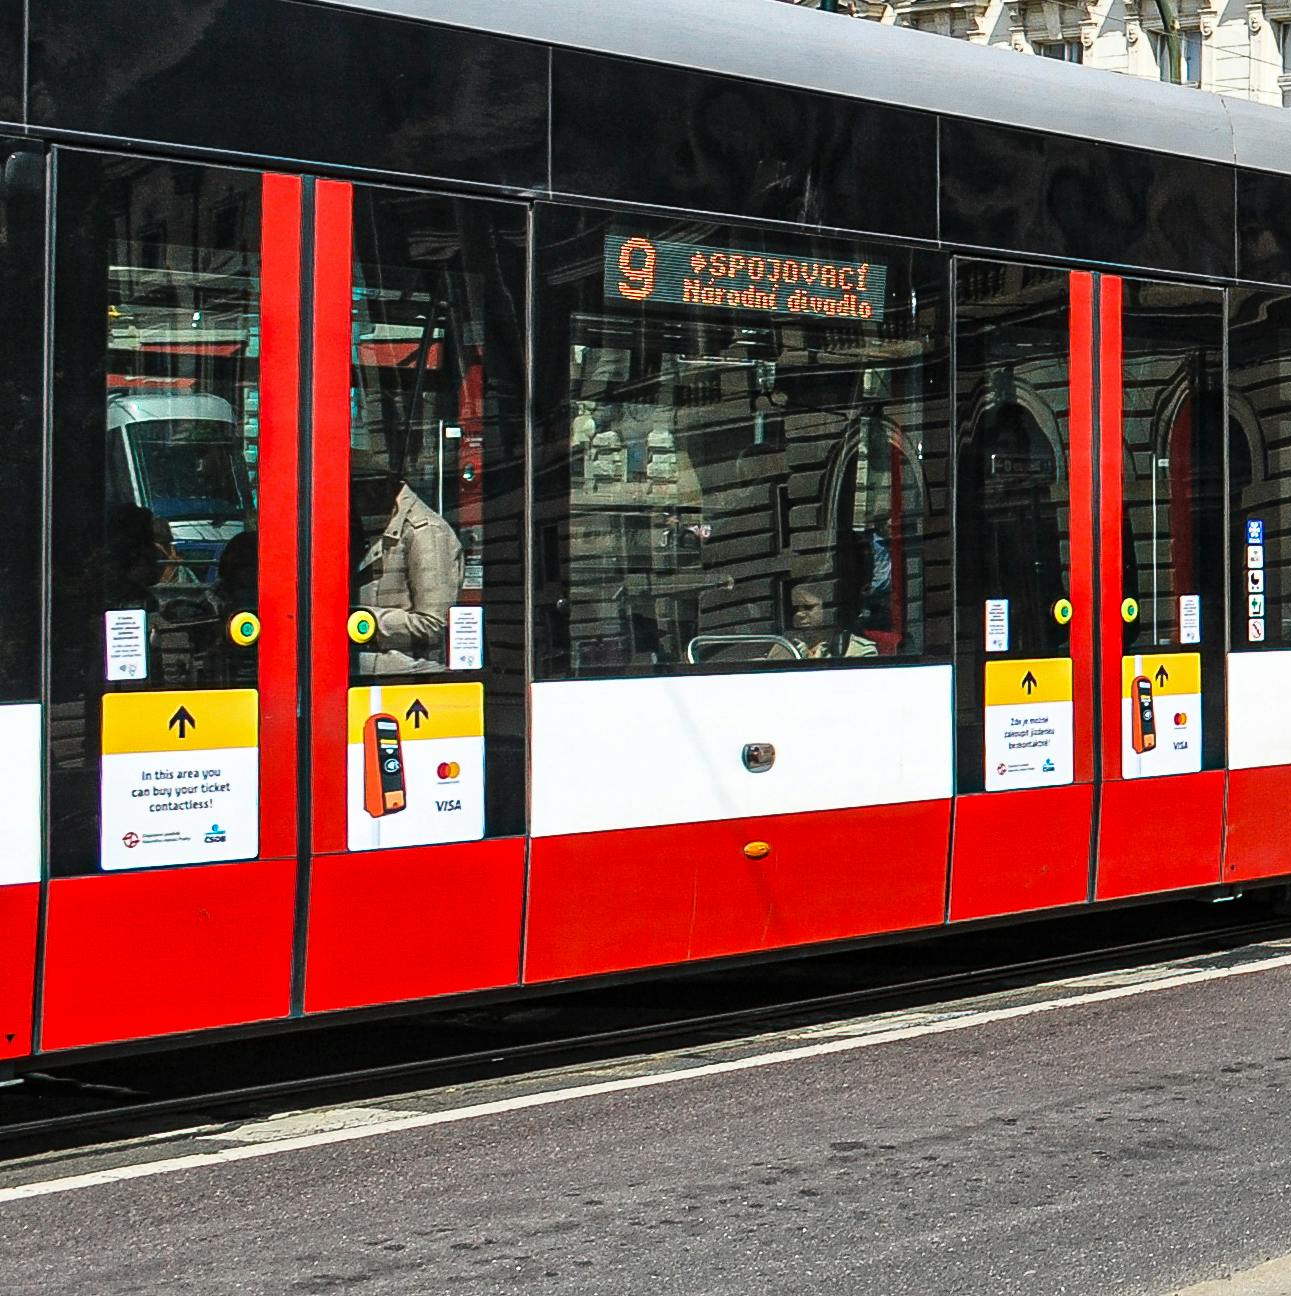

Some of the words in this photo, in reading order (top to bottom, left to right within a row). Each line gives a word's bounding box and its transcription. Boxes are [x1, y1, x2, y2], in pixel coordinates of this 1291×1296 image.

[618, 236, 657, 301] 9
[141, 770, 152, 781] In
[155, 769, 174, 780] this
[176, 770, 199, 779] area
[202, 769, 221, 780] you
[131, 788, 150, 798] can
[152, 786, 172, 797] buy
[175, 785, 199, 797] your
[201, 782, 231, 793] ticket
[149, 798, 213, 812] contactless!
[434, 799, 462, 812] VISA
